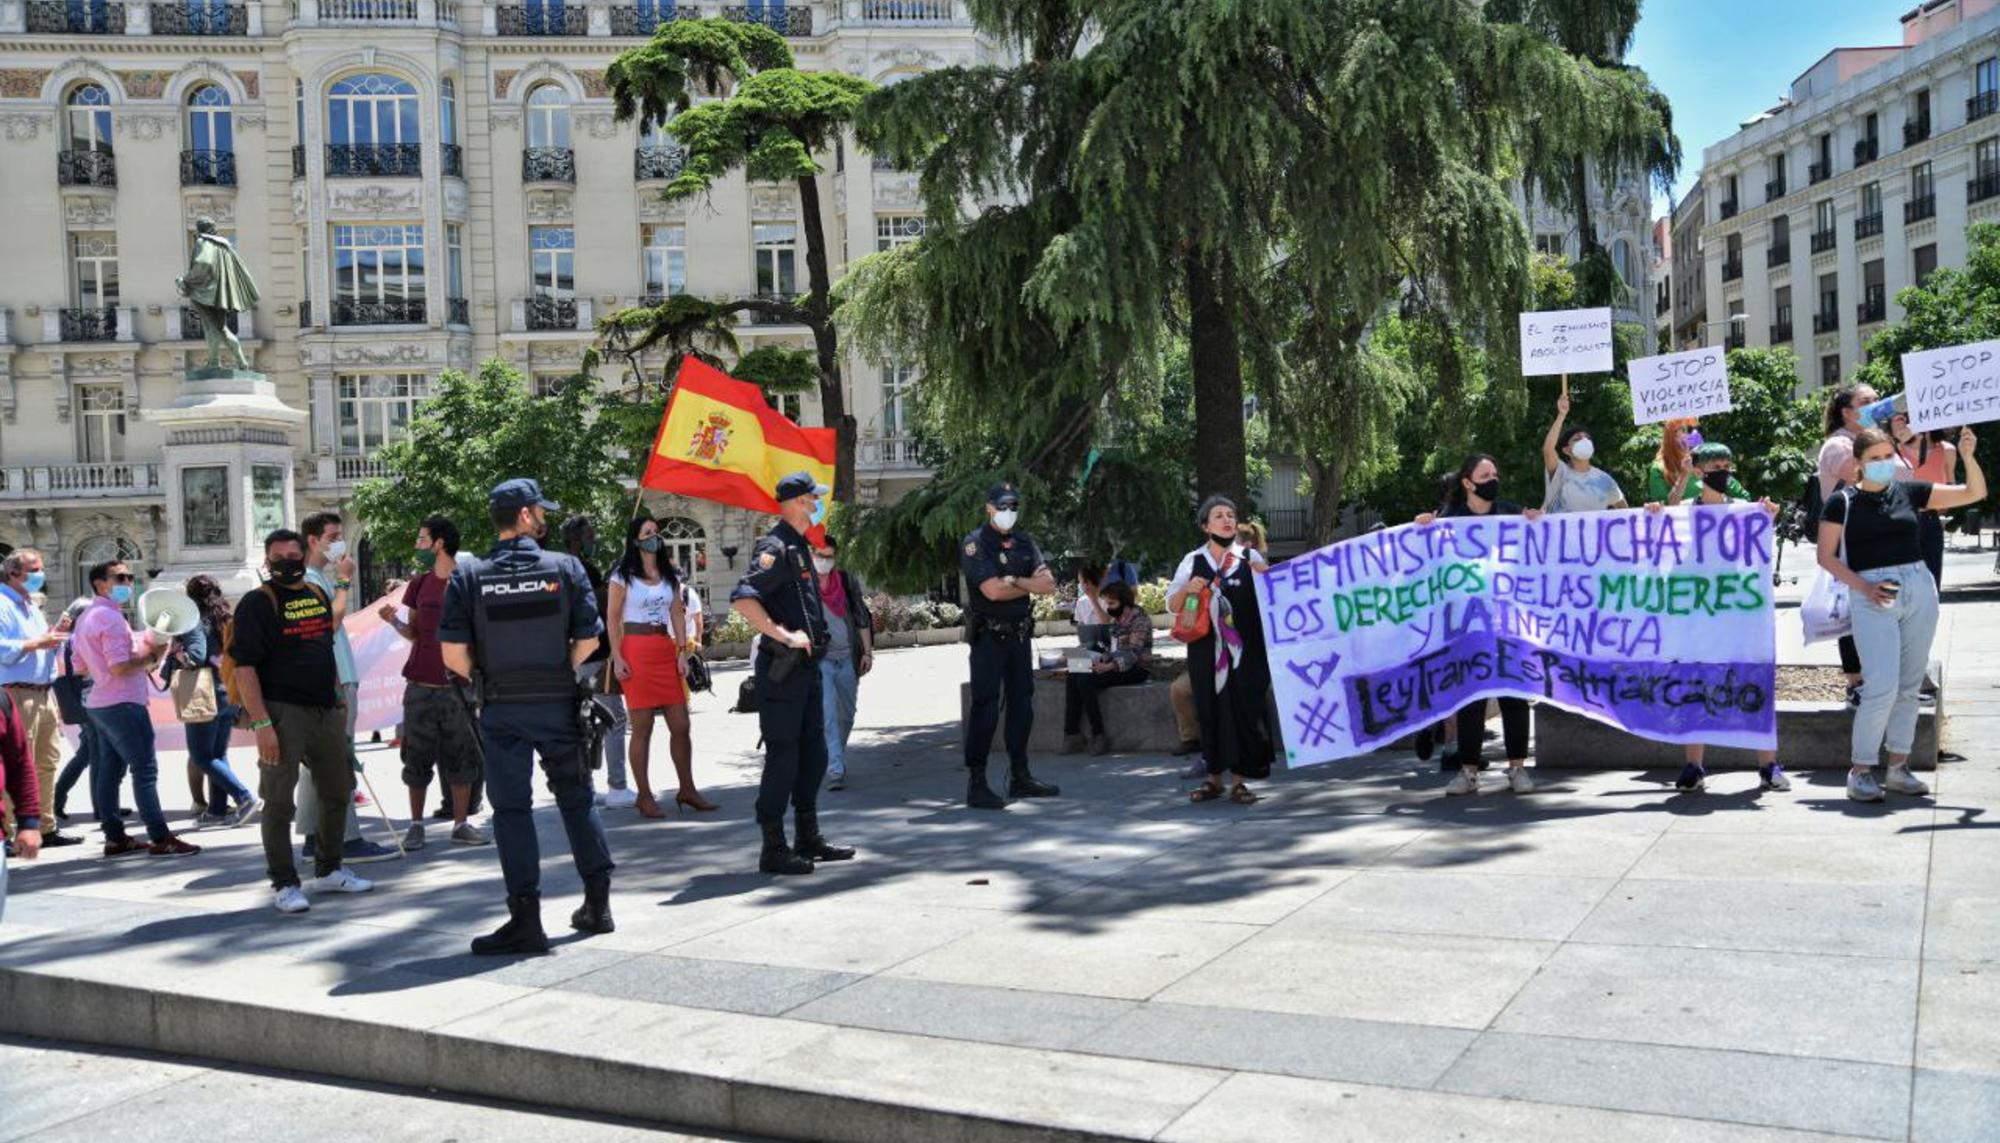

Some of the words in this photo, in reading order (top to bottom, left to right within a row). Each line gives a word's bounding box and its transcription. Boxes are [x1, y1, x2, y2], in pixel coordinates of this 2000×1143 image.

[1655, 355, 1716, 381] STOP
[1931, 351, 1992, 379] STOP
[1640, 378, 1724, 403] VIOLENCIA
[1916, 377, 2000, 403] VIOLENCI
[1647, 393, 1724, 417] MACHISTA
[1918, 395, 2000, 422] MACHIST
[1263, 522, 1489, 606] FEMINISTAS
[1498, 521, 1549, 566] EN
[1557, 513, 1683, 567] LUCHA
[1694, 510, 1771, 567] POR
[481, 579, 549, 597] POLICIA
[1268, 598, 1324, 643] LOS
[1332, 563, 1485, 632] DERECHOS
[1493, 571, 1538, 605] DE
[1540, 572, 1593, 610] LAS
[1597, 572, 1764, 617] MUJERES
[1442, 596, 1492, 642] LA
[1492, 598, 1662, 657] INFANCIA
